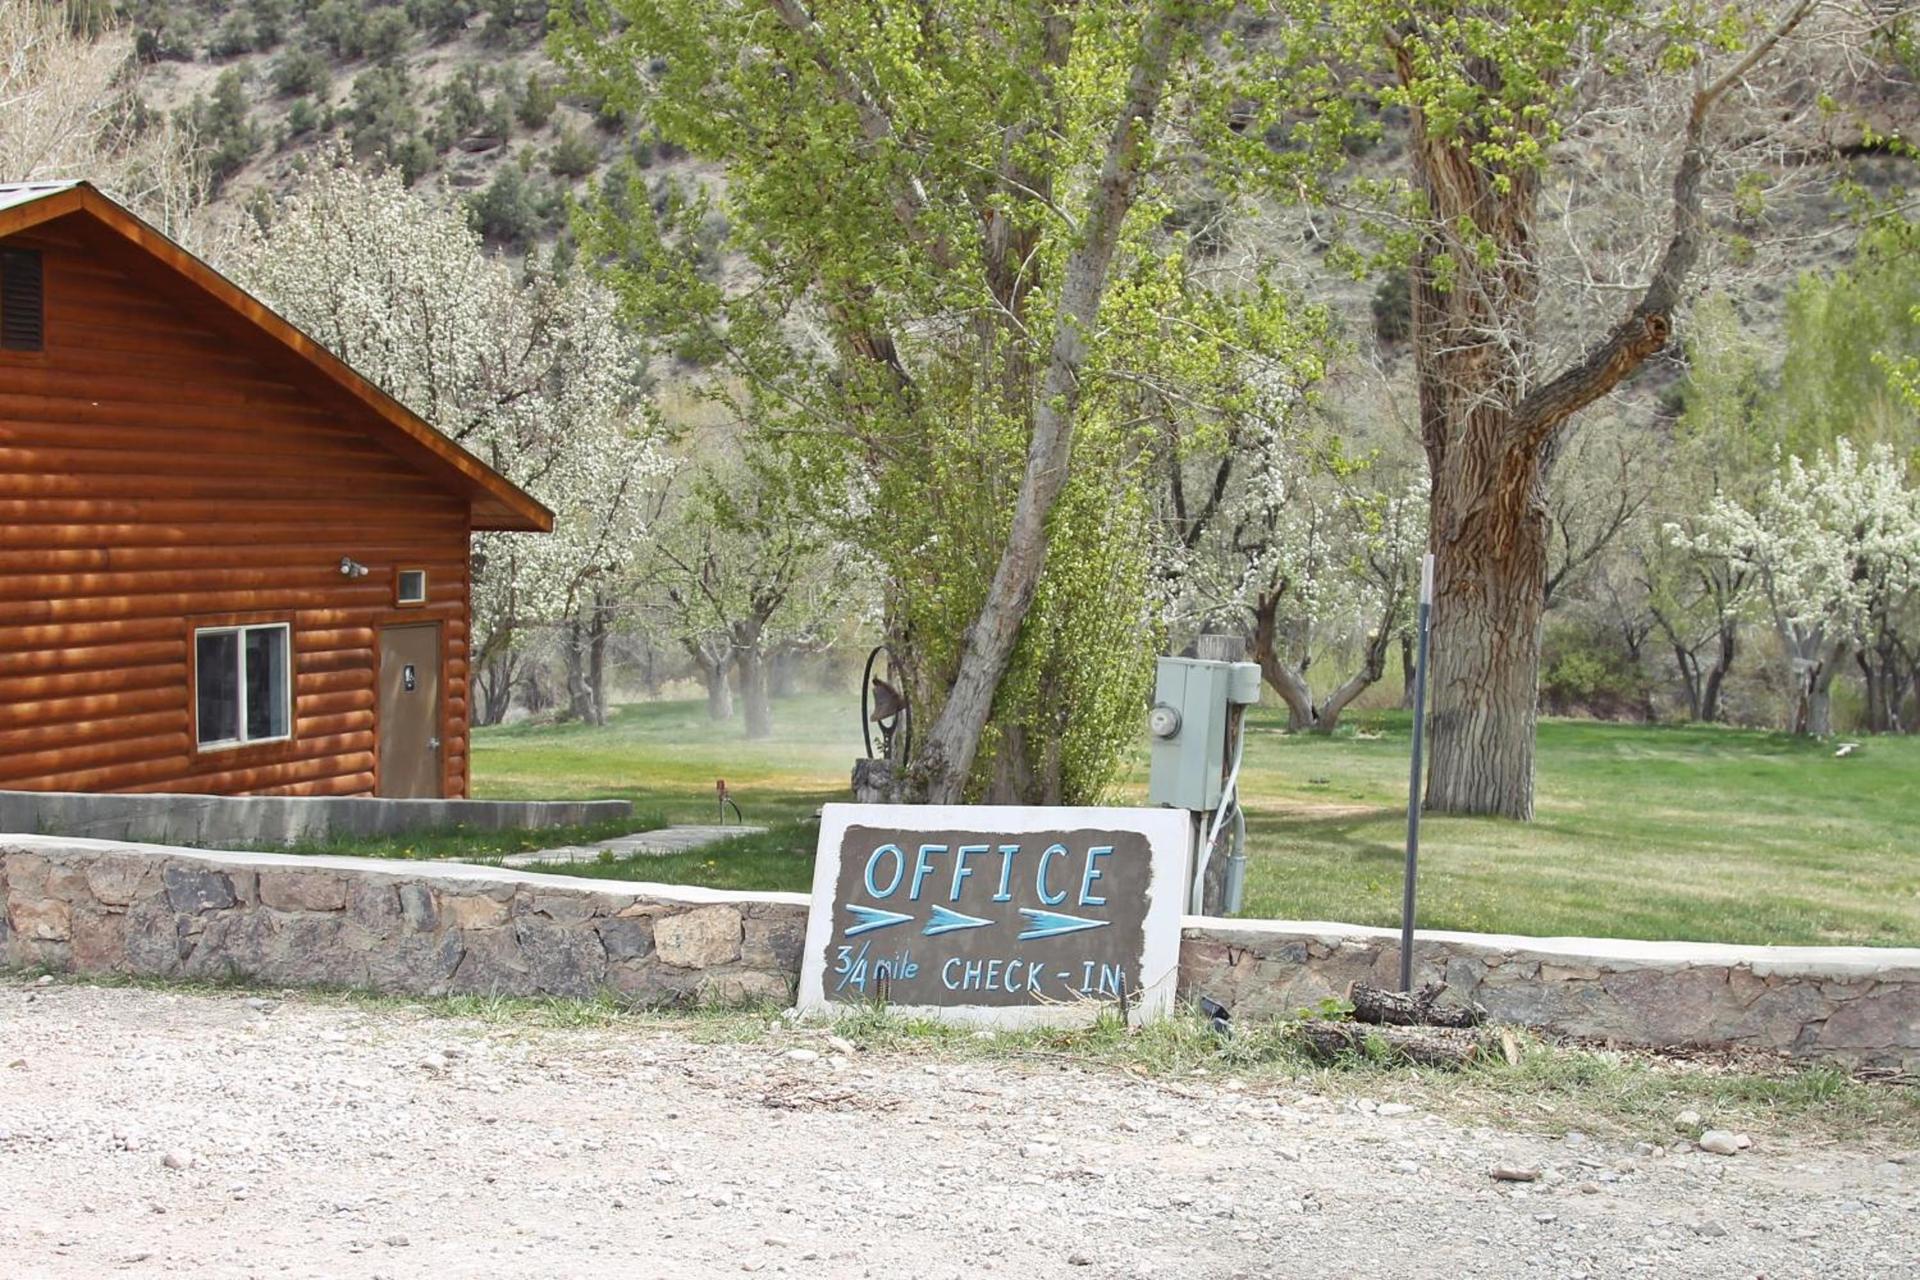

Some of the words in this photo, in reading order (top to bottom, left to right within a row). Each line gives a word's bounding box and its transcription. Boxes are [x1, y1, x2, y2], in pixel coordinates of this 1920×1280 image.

[864, 843, 1114, 906] OFFICE
[834, 940, 869, 992] 3/4
[872, 949, 919, 981] mile
